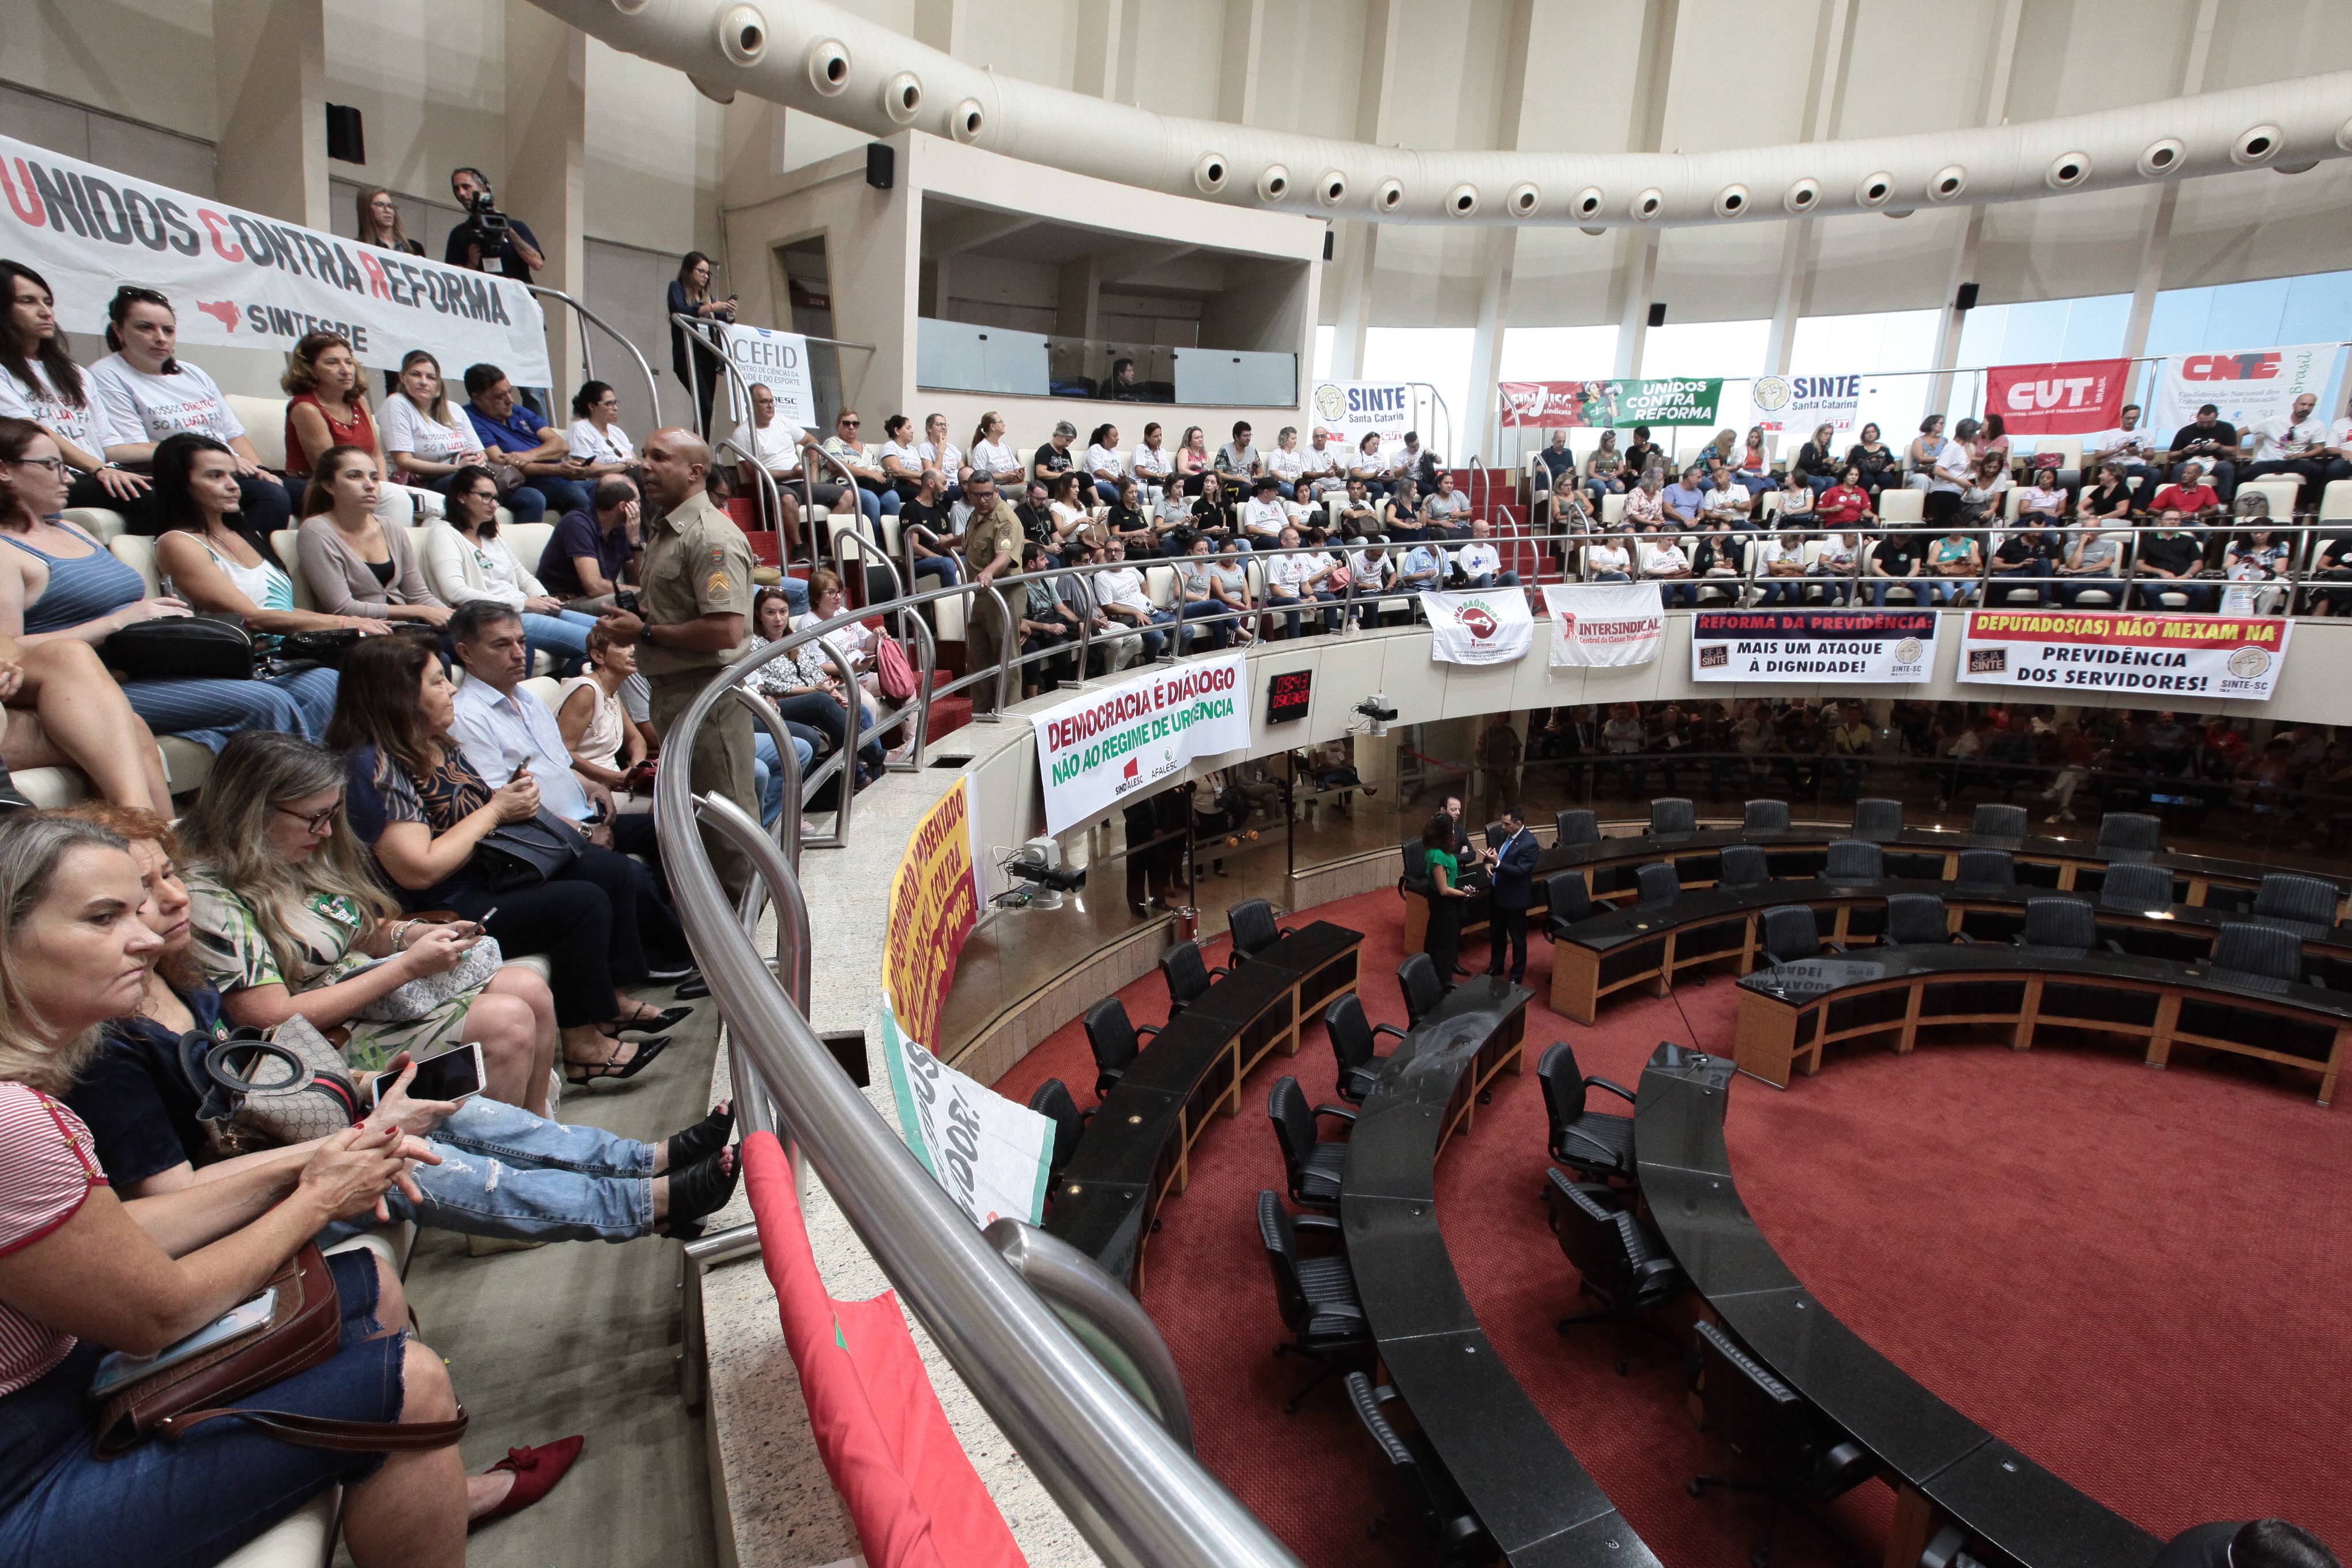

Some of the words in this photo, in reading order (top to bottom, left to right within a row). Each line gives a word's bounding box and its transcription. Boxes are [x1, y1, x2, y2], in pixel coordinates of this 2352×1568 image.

[0, 156, 201, 257] UNIDOS
[197, 208, 365, 295] CONTRA
[357, 250, 511, 326] REFORMA
[733, 338, 797, 369] CEFID
[737, 364, 757, 373] ENTRO
[767, 367, 790, 376] CIÊNCIAS
[2289, 350, 2313, 395] Brasil
[774, 376, 800, 386] ESPORTE
[1642, 380, 1708, 395] UNIDOS
[1793, 374, 1860, 399] SINTE
[2094, 375, 2107, 404] BRASIL
[1348, 386, 1405, 412] SINTE
[1626, 394, 1695, 409] CONTRA
[2007, 376, 2095, 410] CUT
[1543, 408, 1572, 416] sindicato
[1634, 406, 1712, 421] REFORMA
[1792, 399, 1819, 411] Santa
[1822, 399, 1858, 410] Catarina
[1348, 413, 1372, 423] Santa
[1579, 617, 1661, 635] INTERSINDICAL
[1698, 616, 1776, 630] REFORMA
[1781, 616, 1804, 629] DA
[1811, 613, 1934, 630] PREVIDÊNCIA:
[1976, 615, 2110, 637] DEPUTADOS(AS)
[2114, 617, 2157, 638] NÃO
[2161, 622, 2240, 641] MEXAM
[2244, 624, 2276, 642] NA
[1704, 648, 1724, 658] SEJA
[1736, 642, 1778, 655] MAIS
[1784, 642, 1811, 654] UM
[1818, 642, 1883, 656] ATAQUE
[1974, 651, 2000, 664] SEJA
[2041, 646, 2188, 668] PREVIDÊNCIA
[1701, 655, 1727, 667] SINTE
[1748, 657, 1760, 673] À
[1766, 661, 1867, 673] DIGNIDADE!
[1971, 659, 2004, 672] SINTE
[1276, 673, 1309, 693] 09:43
[2016, 668, 2058, 683] DOS
[2064, 669, 2209, 692] SERVIDORES!
[2221, 679, 2268, 691] SINTE-SC
[1047, 689, 1152, 753] DEMOCRACIA
[1154, 678, 1164, 711] É
[1167, 666, 1235, 704] DIÁLOGO
[1051, 752, 1080, 788] NÃO
[1082, 744, 1100, 771] AO
[1102, 722, 1151, 763] REGIME
[1152, 719, 1170, 741] DE
[1171, 697, 1235, 733] URGÊNCIA
[1151, 759, 1178, 780] AFALESC
[1115, 774, 1144, 796] SINDALESC
[930, 840, 962, 913] CONTRA
